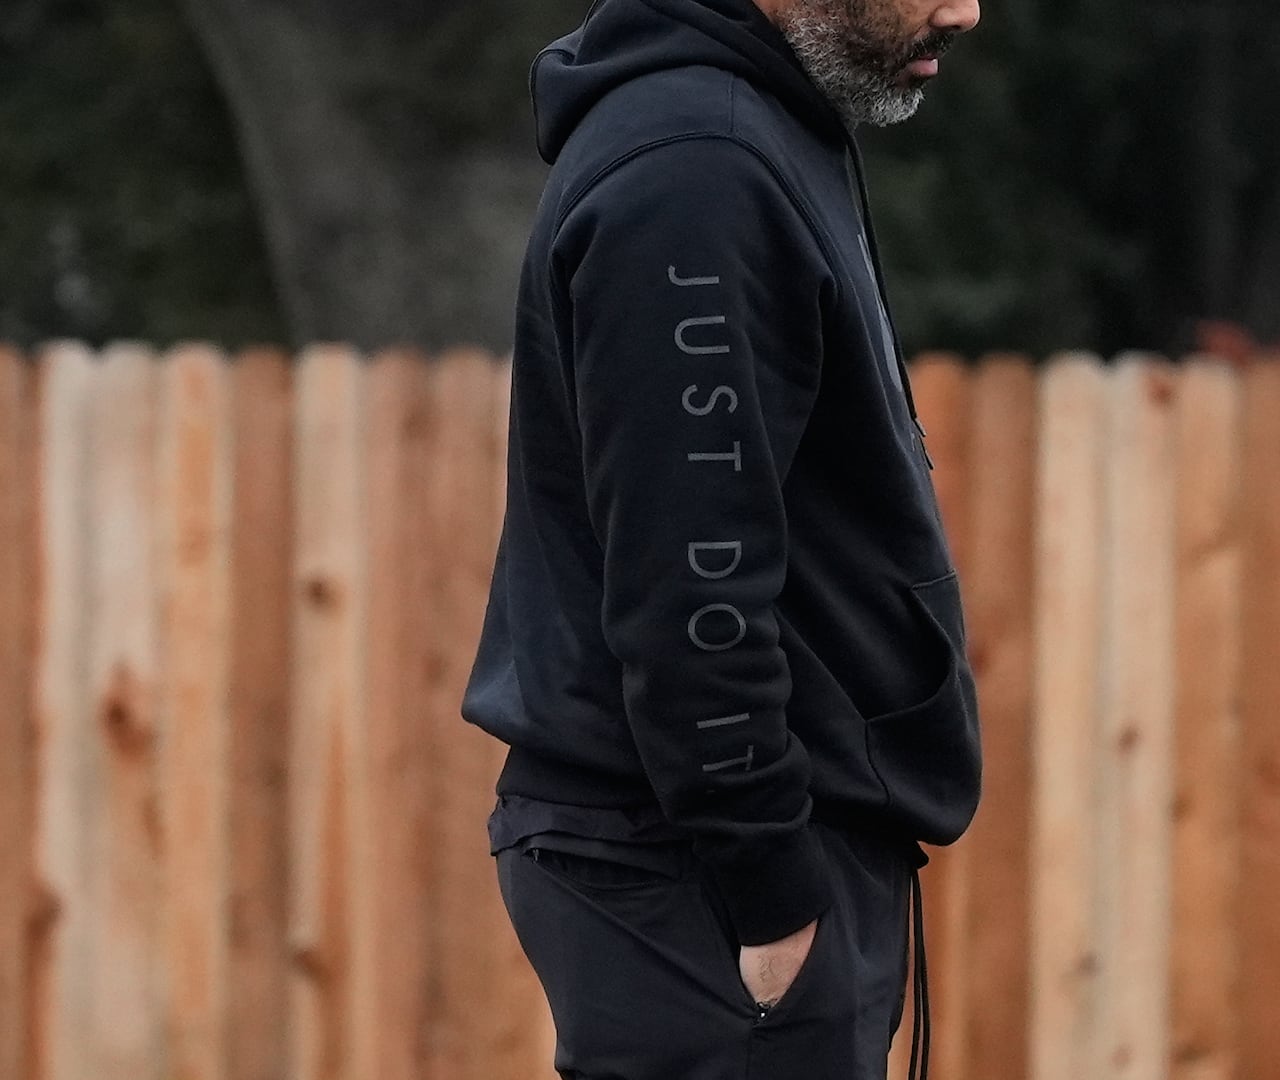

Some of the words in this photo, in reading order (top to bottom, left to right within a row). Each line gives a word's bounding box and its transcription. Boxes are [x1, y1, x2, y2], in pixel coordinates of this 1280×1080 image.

[668, 265, 742, 472] JUST
[687, 540, 747, 652] DO
[696, 712, 754, 773] IT
